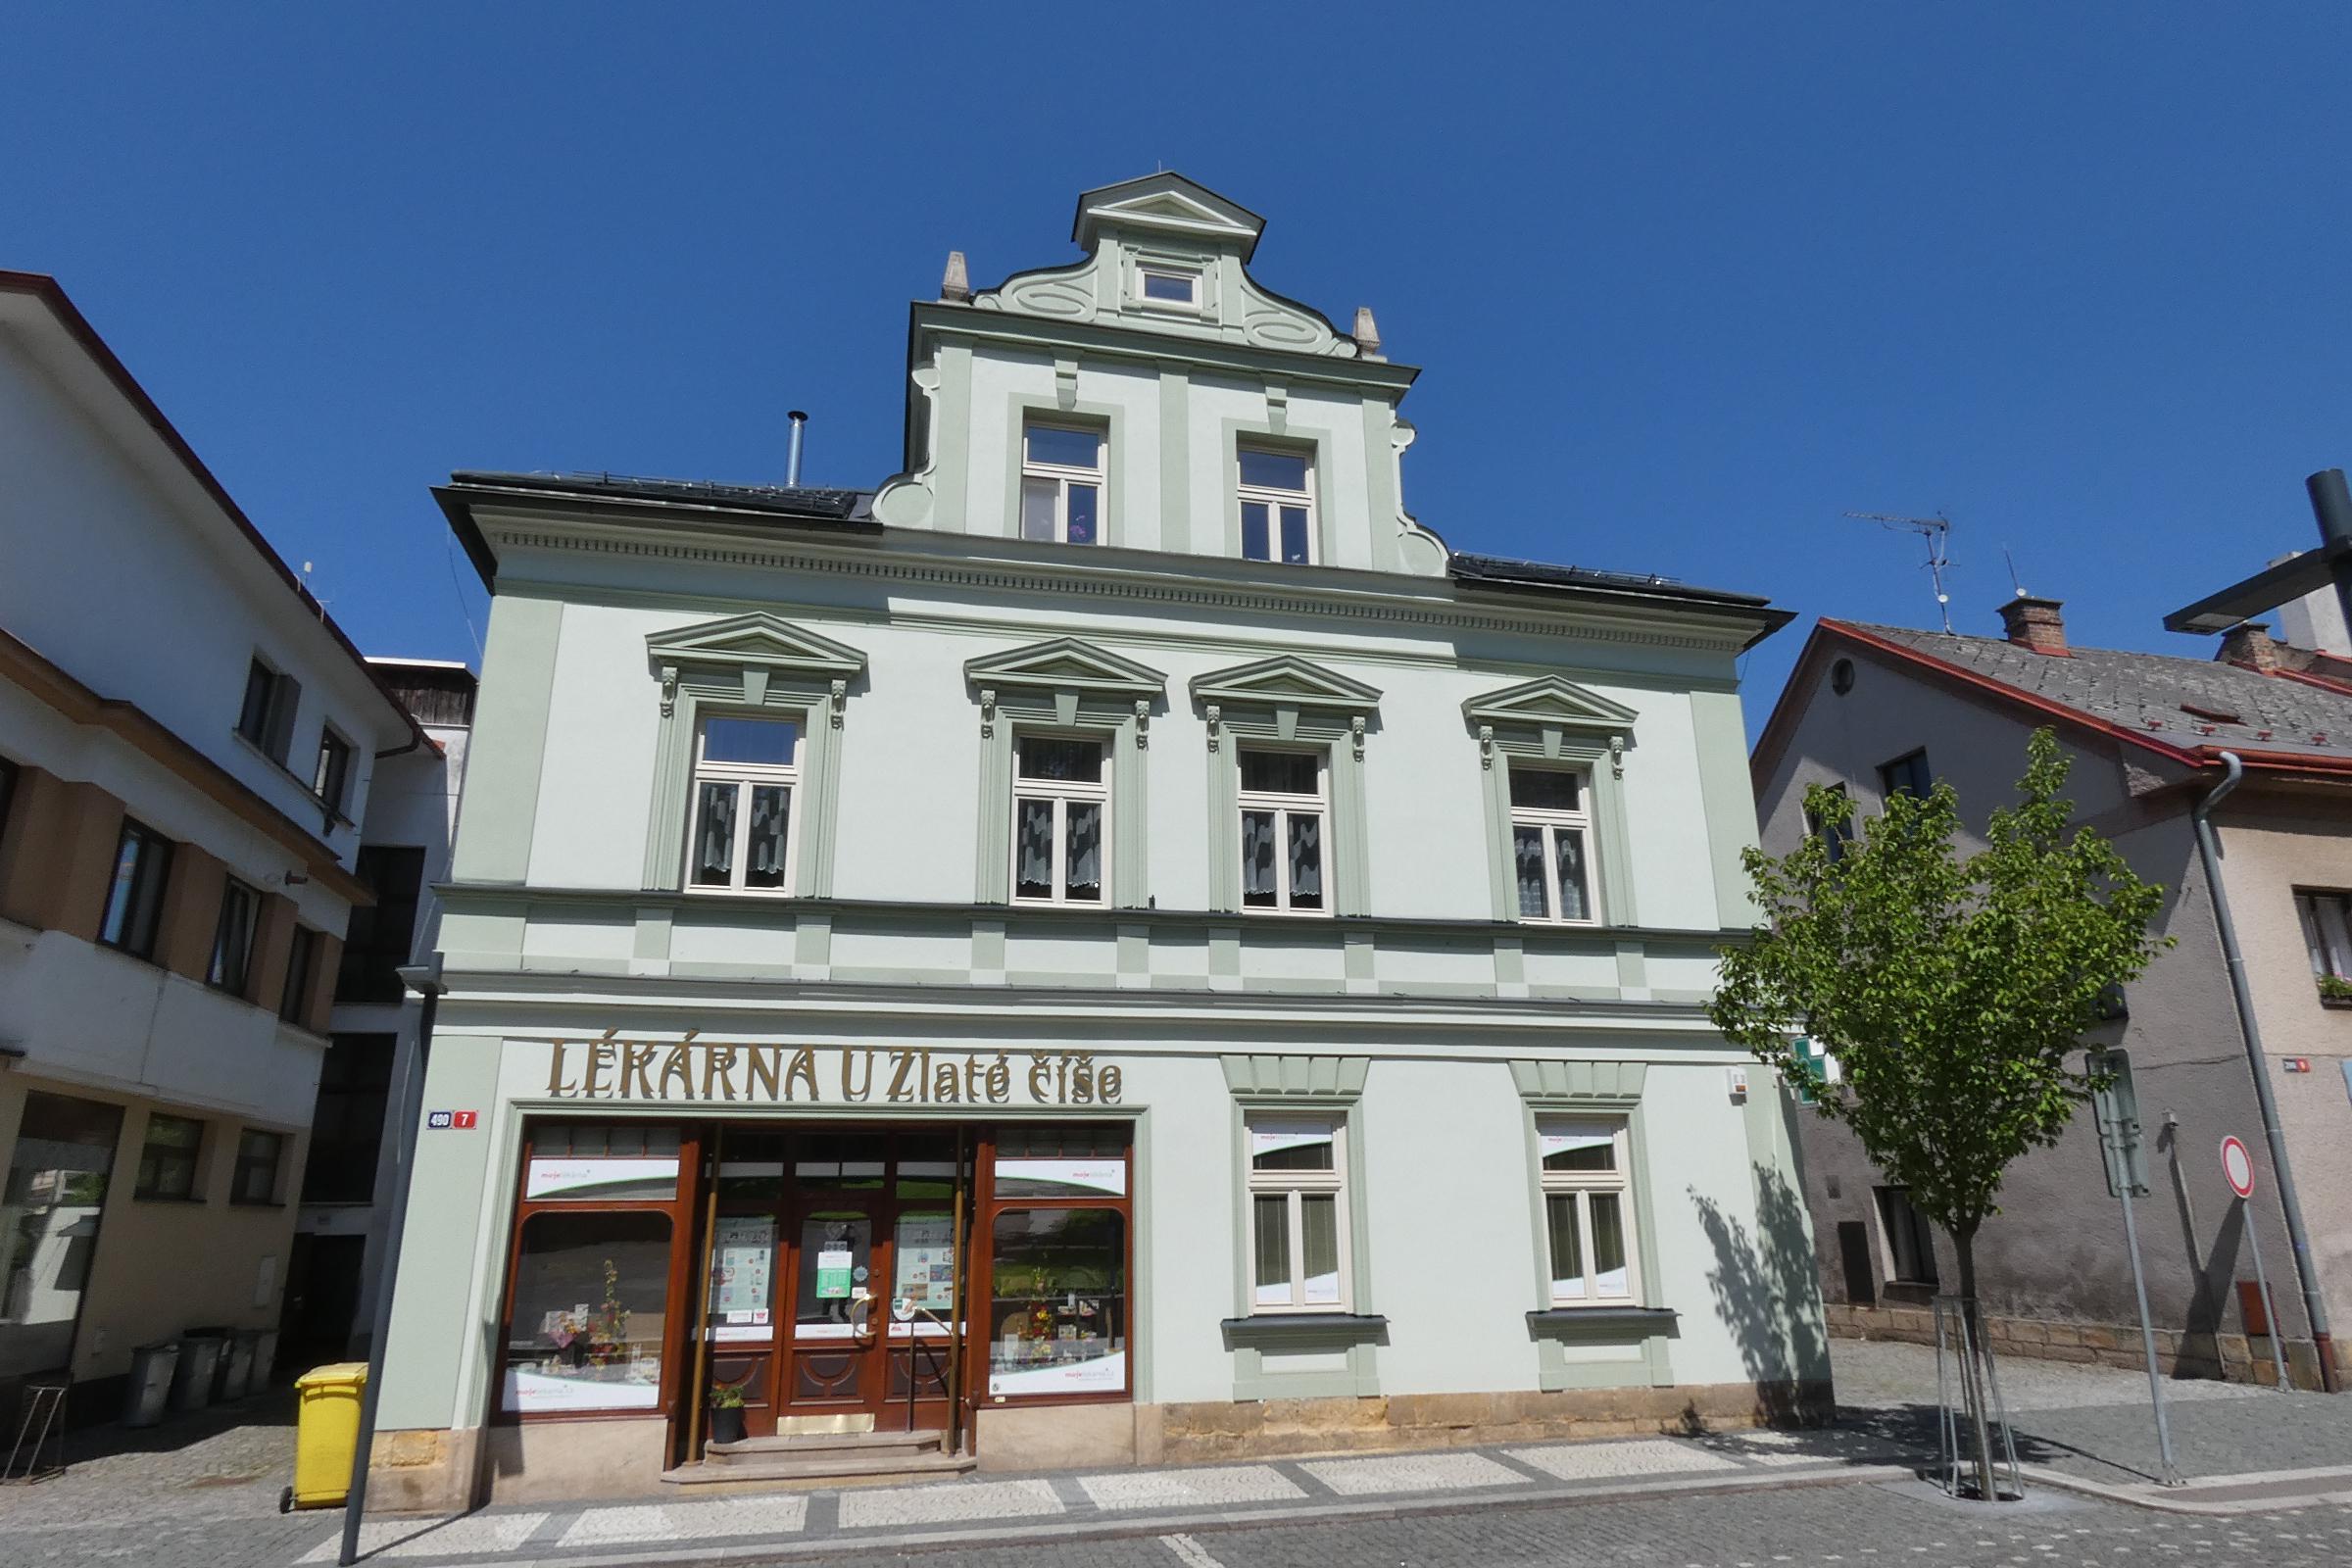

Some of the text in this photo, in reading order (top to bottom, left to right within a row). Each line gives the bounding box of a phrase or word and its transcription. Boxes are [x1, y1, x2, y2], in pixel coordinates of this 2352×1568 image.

[545, 1027, 1122, 1099] LÉKÁRNA U Zlaté číše
[430, 1113, 450, 1126] 490
[462, 1113, 469, 1126] 7
